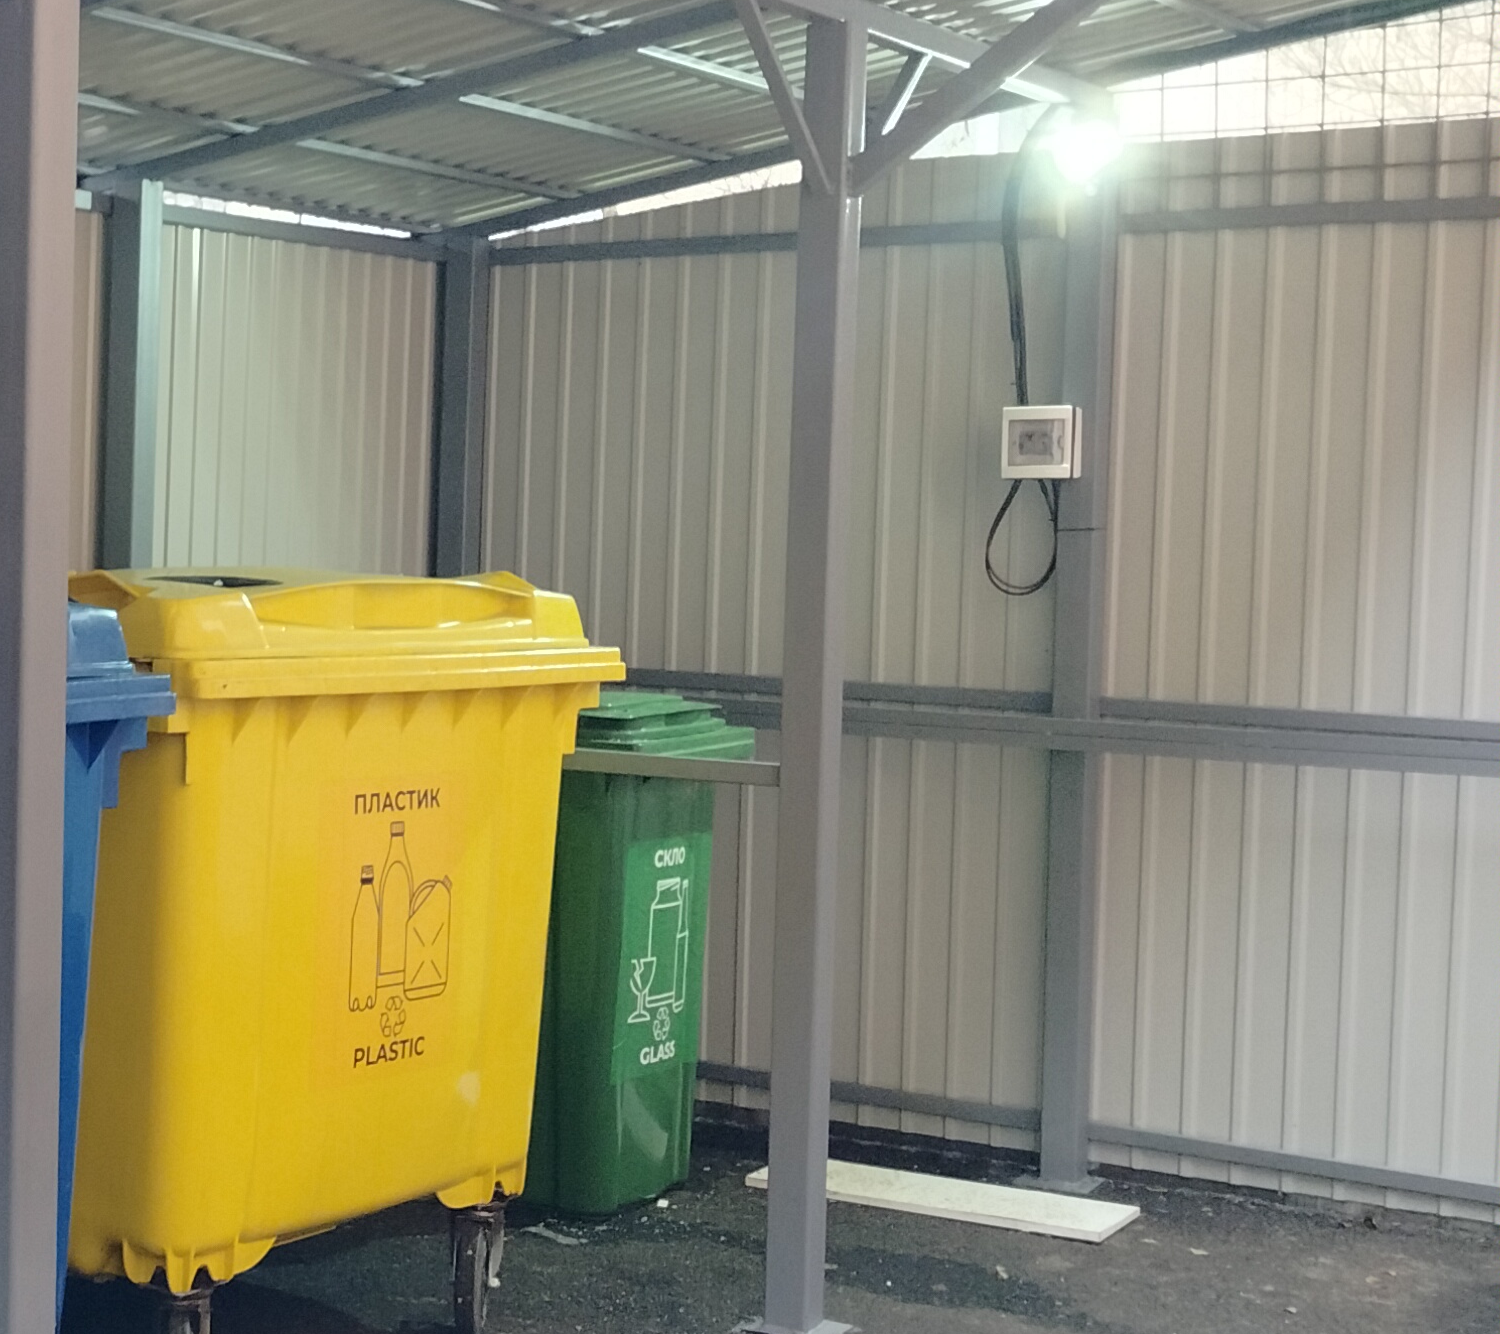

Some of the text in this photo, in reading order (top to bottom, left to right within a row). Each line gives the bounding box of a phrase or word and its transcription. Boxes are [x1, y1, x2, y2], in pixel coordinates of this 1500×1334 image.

[354, 787, 441, 815] ПЛАСТИК
[654, 846, 686, 868] СКЛО
[353, 1036, 425, 1069] PLASTIC
[640, 1040, 676, 1065] GLASS
